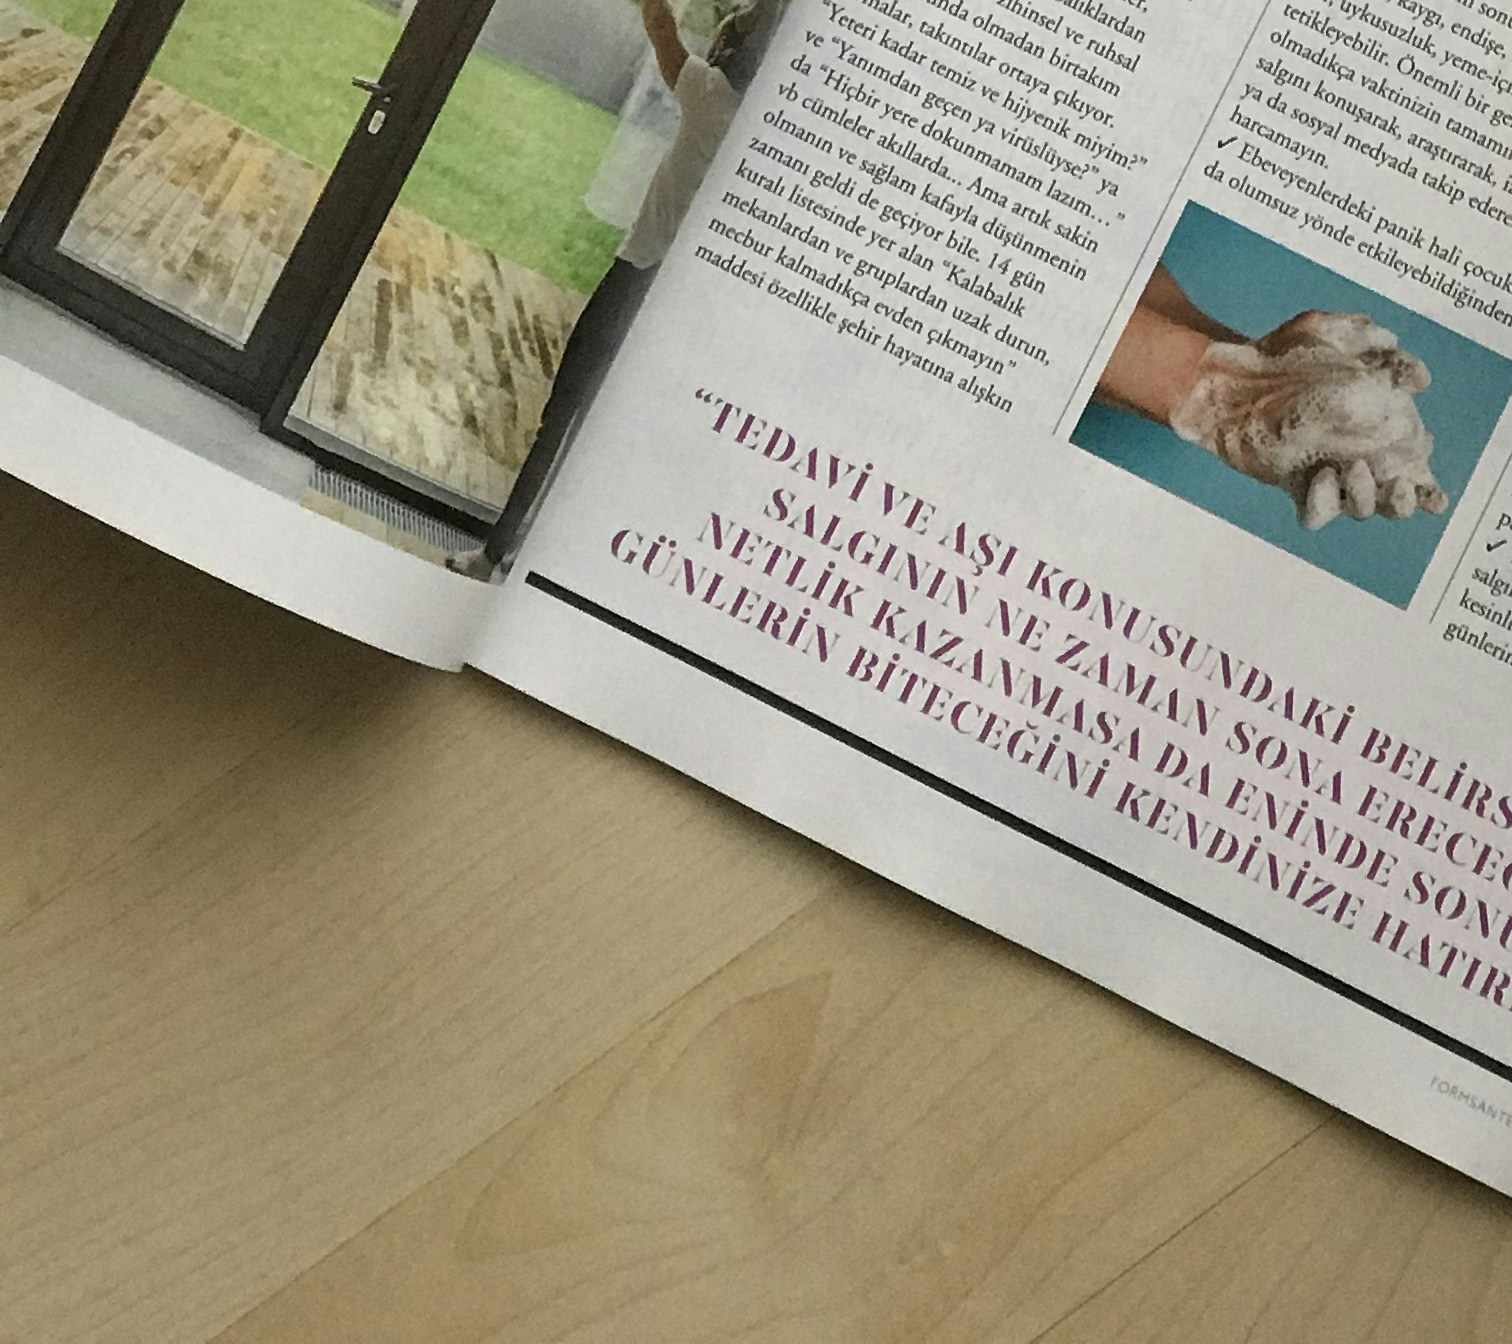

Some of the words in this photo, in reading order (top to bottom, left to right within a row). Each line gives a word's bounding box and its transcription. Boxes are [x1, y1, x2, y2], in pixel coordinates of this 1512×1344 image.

[918, 20, 997, 67] takıntılar
[998, 62, 1051, 96] ortaya
[1053, 89, 1115, 129] çıkıyor.
[972, 13, 1045, 60] olmadan
[1048, 46, 1121, 98] birtakım
[748, 136, 811, 176] zamanı
[809, 169, 857, 198] geldi
[857, 187, 880, 211] de
[878, 204, 945, 242] geçiyor
[945, 229, 980, 263] bile.
[987, 252, 1012, 276] 14
[1009, 269, 1046, 295] gün
[1203, 159, 1225, 184] da
[1228, 174, 1300, 220] olumsuz
[1298, 212, 1356, 247] yönde
[694, 245, 767, 289] maddesi
[766, 278, 838, 325] özellikle
[837, 317, 882, 346] şehir
[882, 333, 955, 384] hayatına
[956, 375, 1013, 414] alışkın
[763, 487, 980, 616] SALGININ
[984, 598, 1051, 653] NE
[1054, 633, 1221, 737] ZAMAN
[1224, 720, 1342, 806] SONA
[883, 481, 937, 536] VE
[937, 521, 1019, 577] AŞI
[1025, 559, 1356, 745] KONUSUNDAKİ
[610, 529, 841, 664] GÜNLERİN
[845, 645, 1111, 800] BİTECEĞİNİ
[1113, 781, 1365, 931] KENDİNİZE
[696, 511, 865, 618] NETLİK
[869, 598, 1140, 763] KAZANMASA
[1154, 741, 1210, 798] DA
[1224, 777, 1399, 888] ENİNDE
